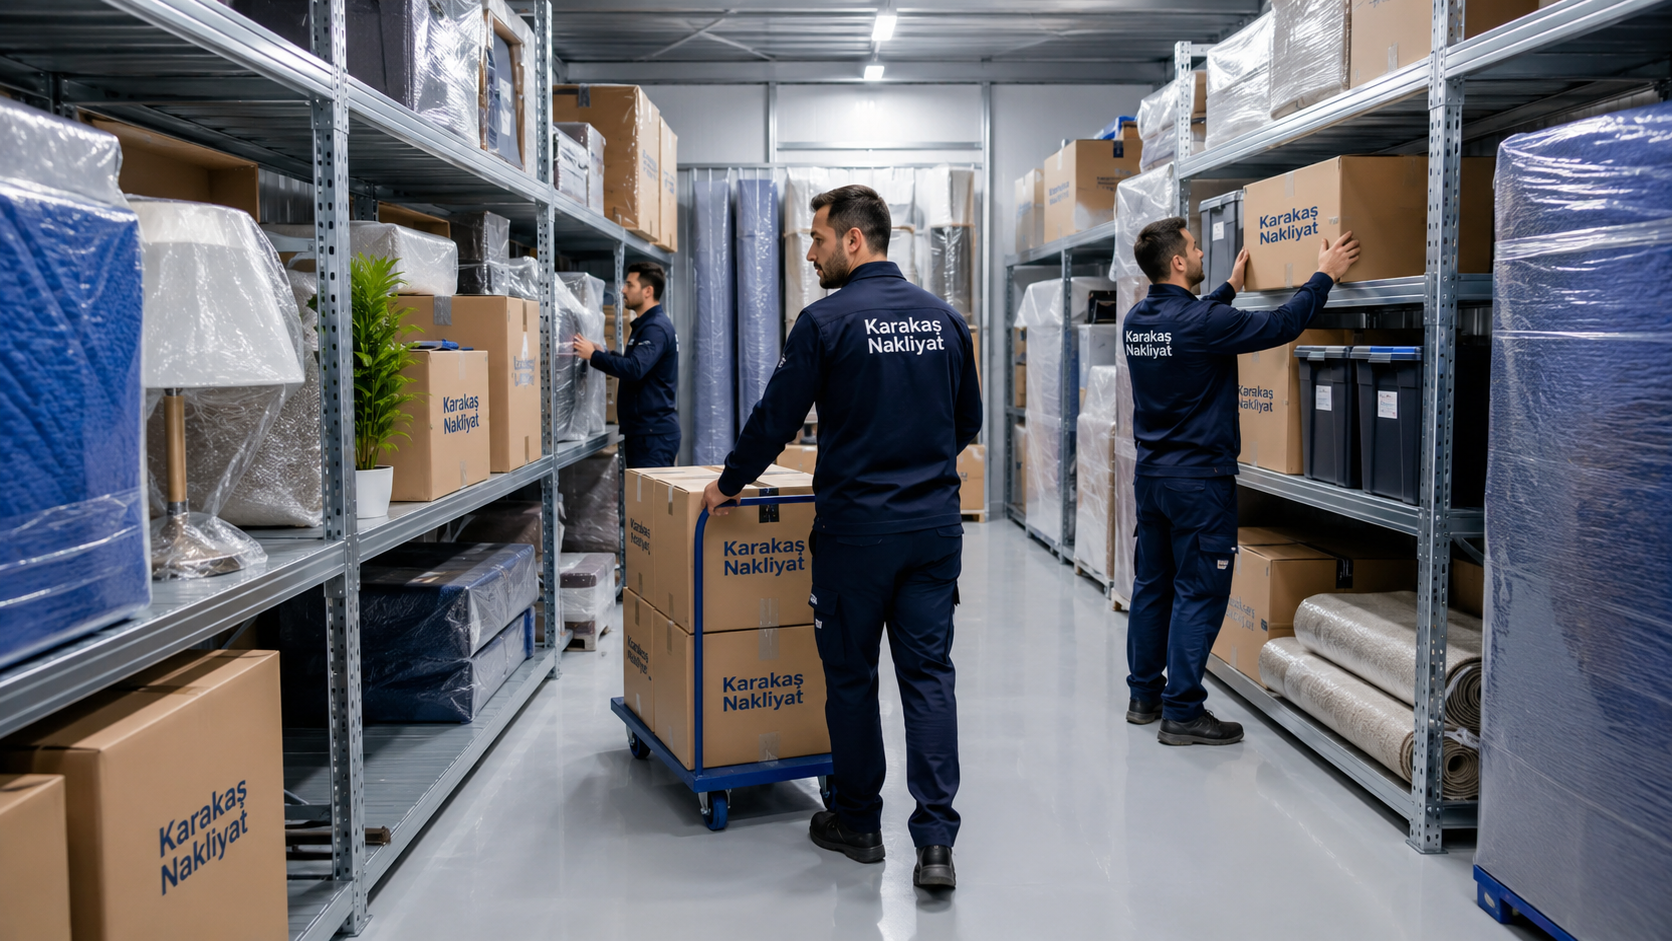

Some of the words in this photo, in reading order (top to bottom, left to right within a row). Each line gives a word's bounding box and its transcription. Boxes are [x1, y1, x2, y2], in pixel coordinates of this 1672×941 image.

[1260, 206, 1319, 230] Karakaş
[1260, 221, 1319, 246] Nakliyat
[864, 316, 942, 335] Karakaş
[868, 335, 945, 355] Nakliyat
[1126, 330, 1172, 344] Karakaş
[1126, 344, 1173, 359] Nakliyat
[443, 393, 479, 413] Karakaş
[444, 412, 480, 434] Nakliyat
[724, 537, 805, 556] Karakaş
[724, 556, 805, 577] Nakliyat
[723, 672, 804, 694] Karakaş
[723, 689, 804, 712] Nakliyat
[159, 780, 247, 858] Karakaş
[161, 809, 248, 896] Nakliyat
